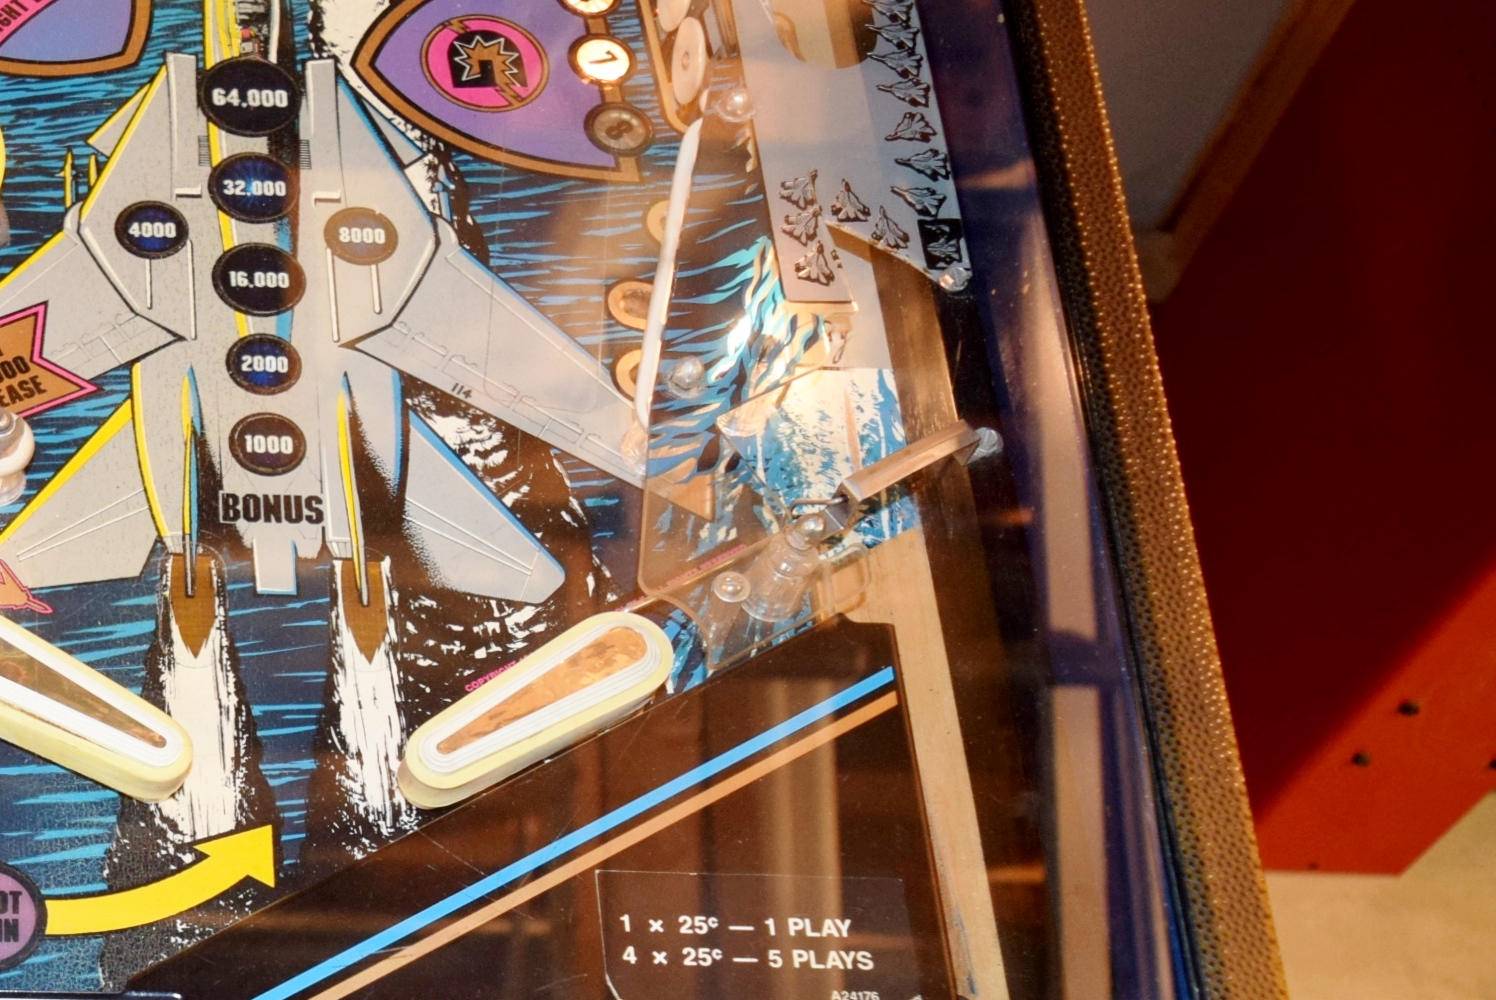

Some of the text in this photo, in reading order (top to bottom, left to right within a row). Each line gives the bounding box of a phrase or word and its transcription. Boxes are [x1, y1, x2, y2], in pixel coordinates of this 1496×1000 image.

[128, 221, 176, 239] 4000
[338, 226, 386, 244] 8000
[240, 354, 289, 374] 2000
[244, 434, 294, 455] 1000
[221, 492, 325, 525] BONUS
[620, 914, 630, 932] 1
[764, 918, 775, 935] 1
[788, 918, 851, 937] PLAY
[622, 946, 637, 964] 4
[768, 950, 783, 968] 5
[792, 950, 874, 970] PLAYS
